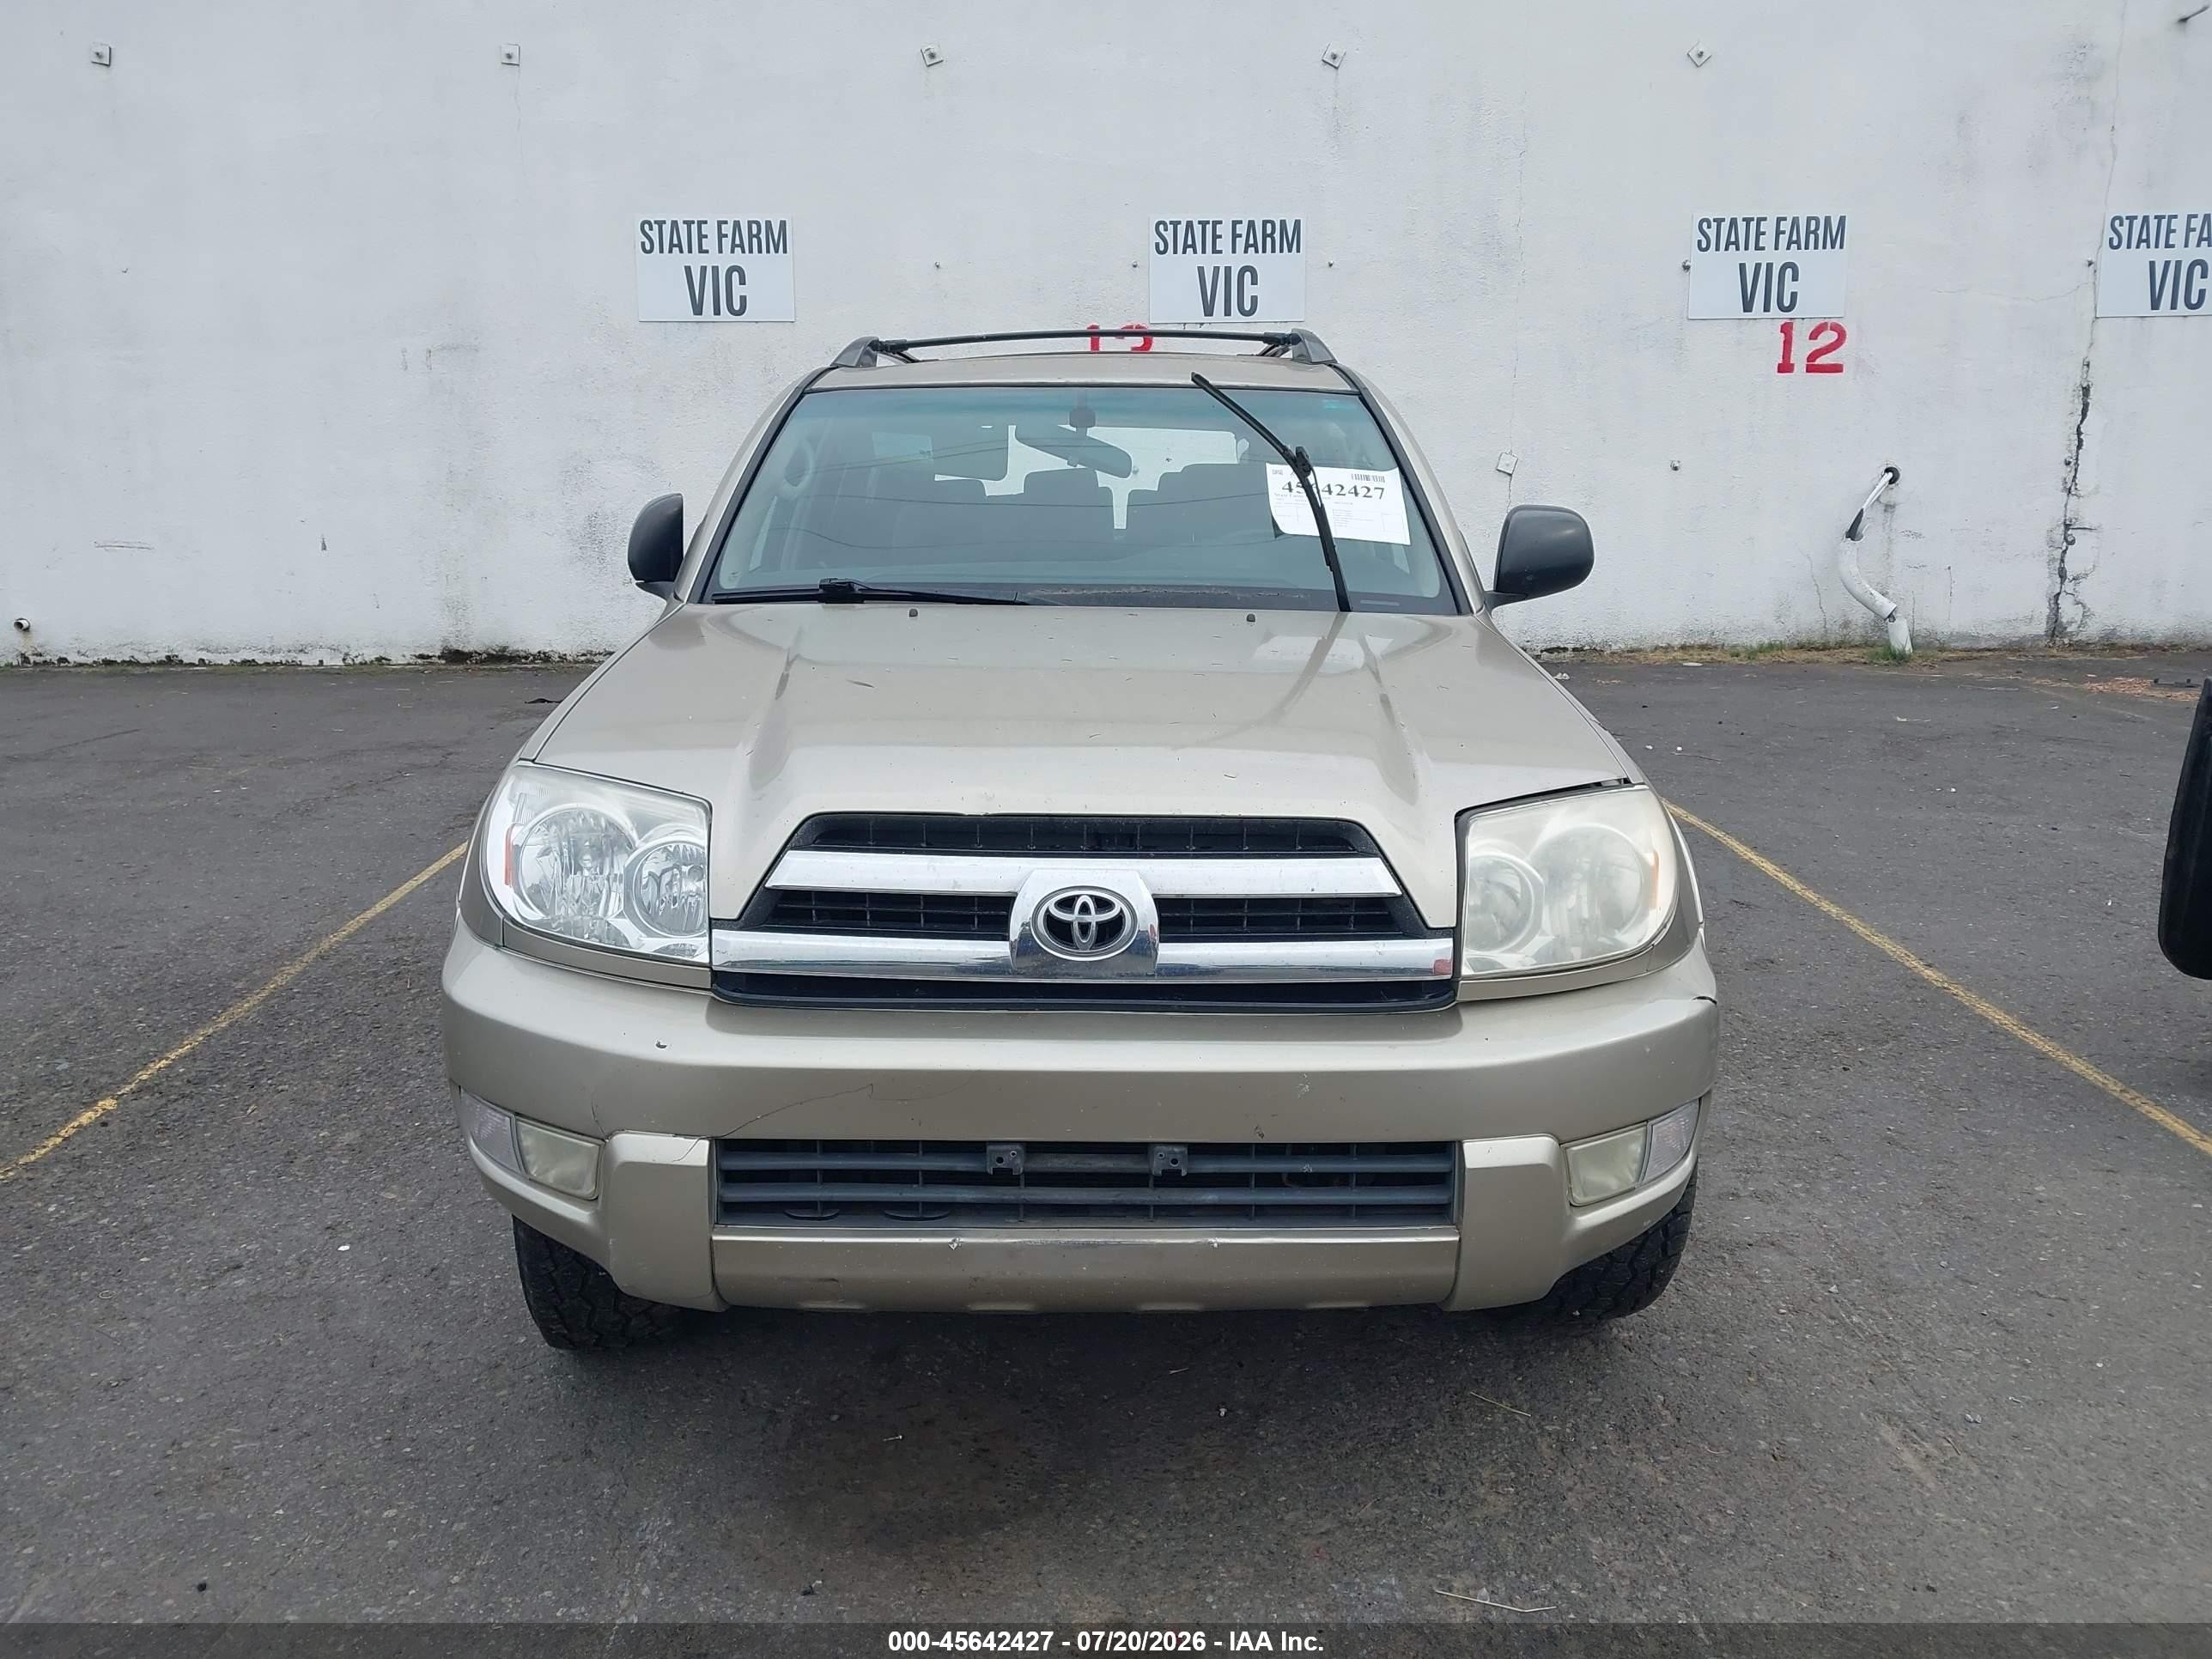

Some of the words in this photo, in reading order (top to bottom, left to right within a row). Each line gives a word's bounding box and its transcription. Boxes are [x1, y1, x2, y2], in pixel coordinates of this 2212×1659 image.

[640, 219, 709, 254] STATE
[716, 219, 788, 254] FARM
[1153, 219, 1224, 255] STATE
[1231, 218, 1302, 255] FARM
[1697, 216, 1768, 252] STATE
[1773, 215, 1847, 251] FARM
[2108, 214, 2179, 251] STATE
[684, 264, 747, 317] VIC
[1197, 264, 1259, 318] VIC
[1738, 260, 1800, 313] VIC
[2148, 258, 2209, 311] VIC
[1777, 320, 1848, 374] 12
